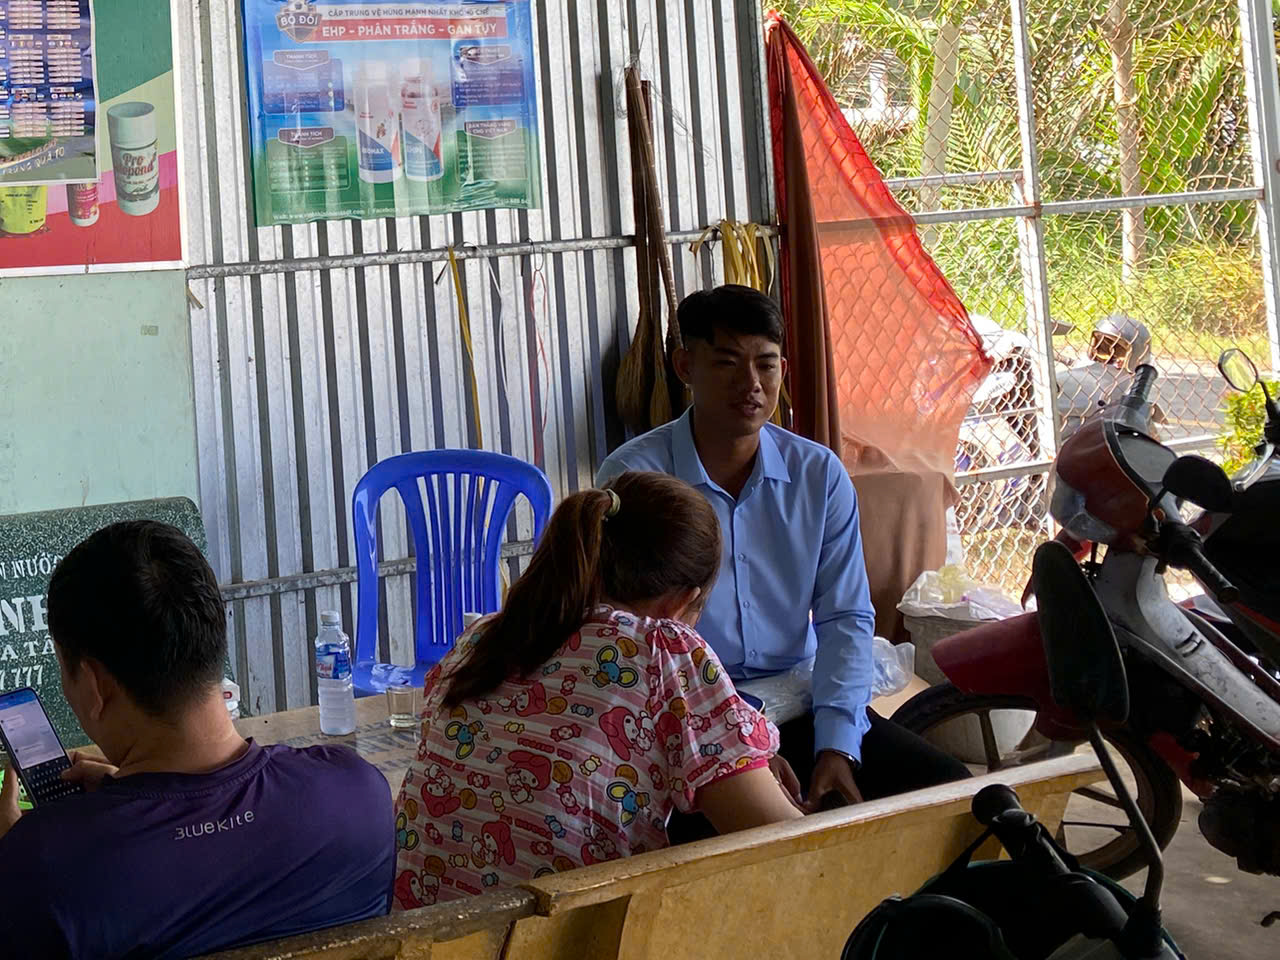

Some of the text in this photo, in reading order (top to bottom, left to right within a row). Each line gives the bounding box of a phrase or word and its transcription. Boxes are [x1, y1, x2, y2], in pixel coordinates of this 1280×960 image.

[345, 8, 370, 17] TRUNG
[280, 14, 318, 26] BỘ ĐỘI
[322, 19, 497, 37] EHP PHÂN TRẮNG GAN TỤY
